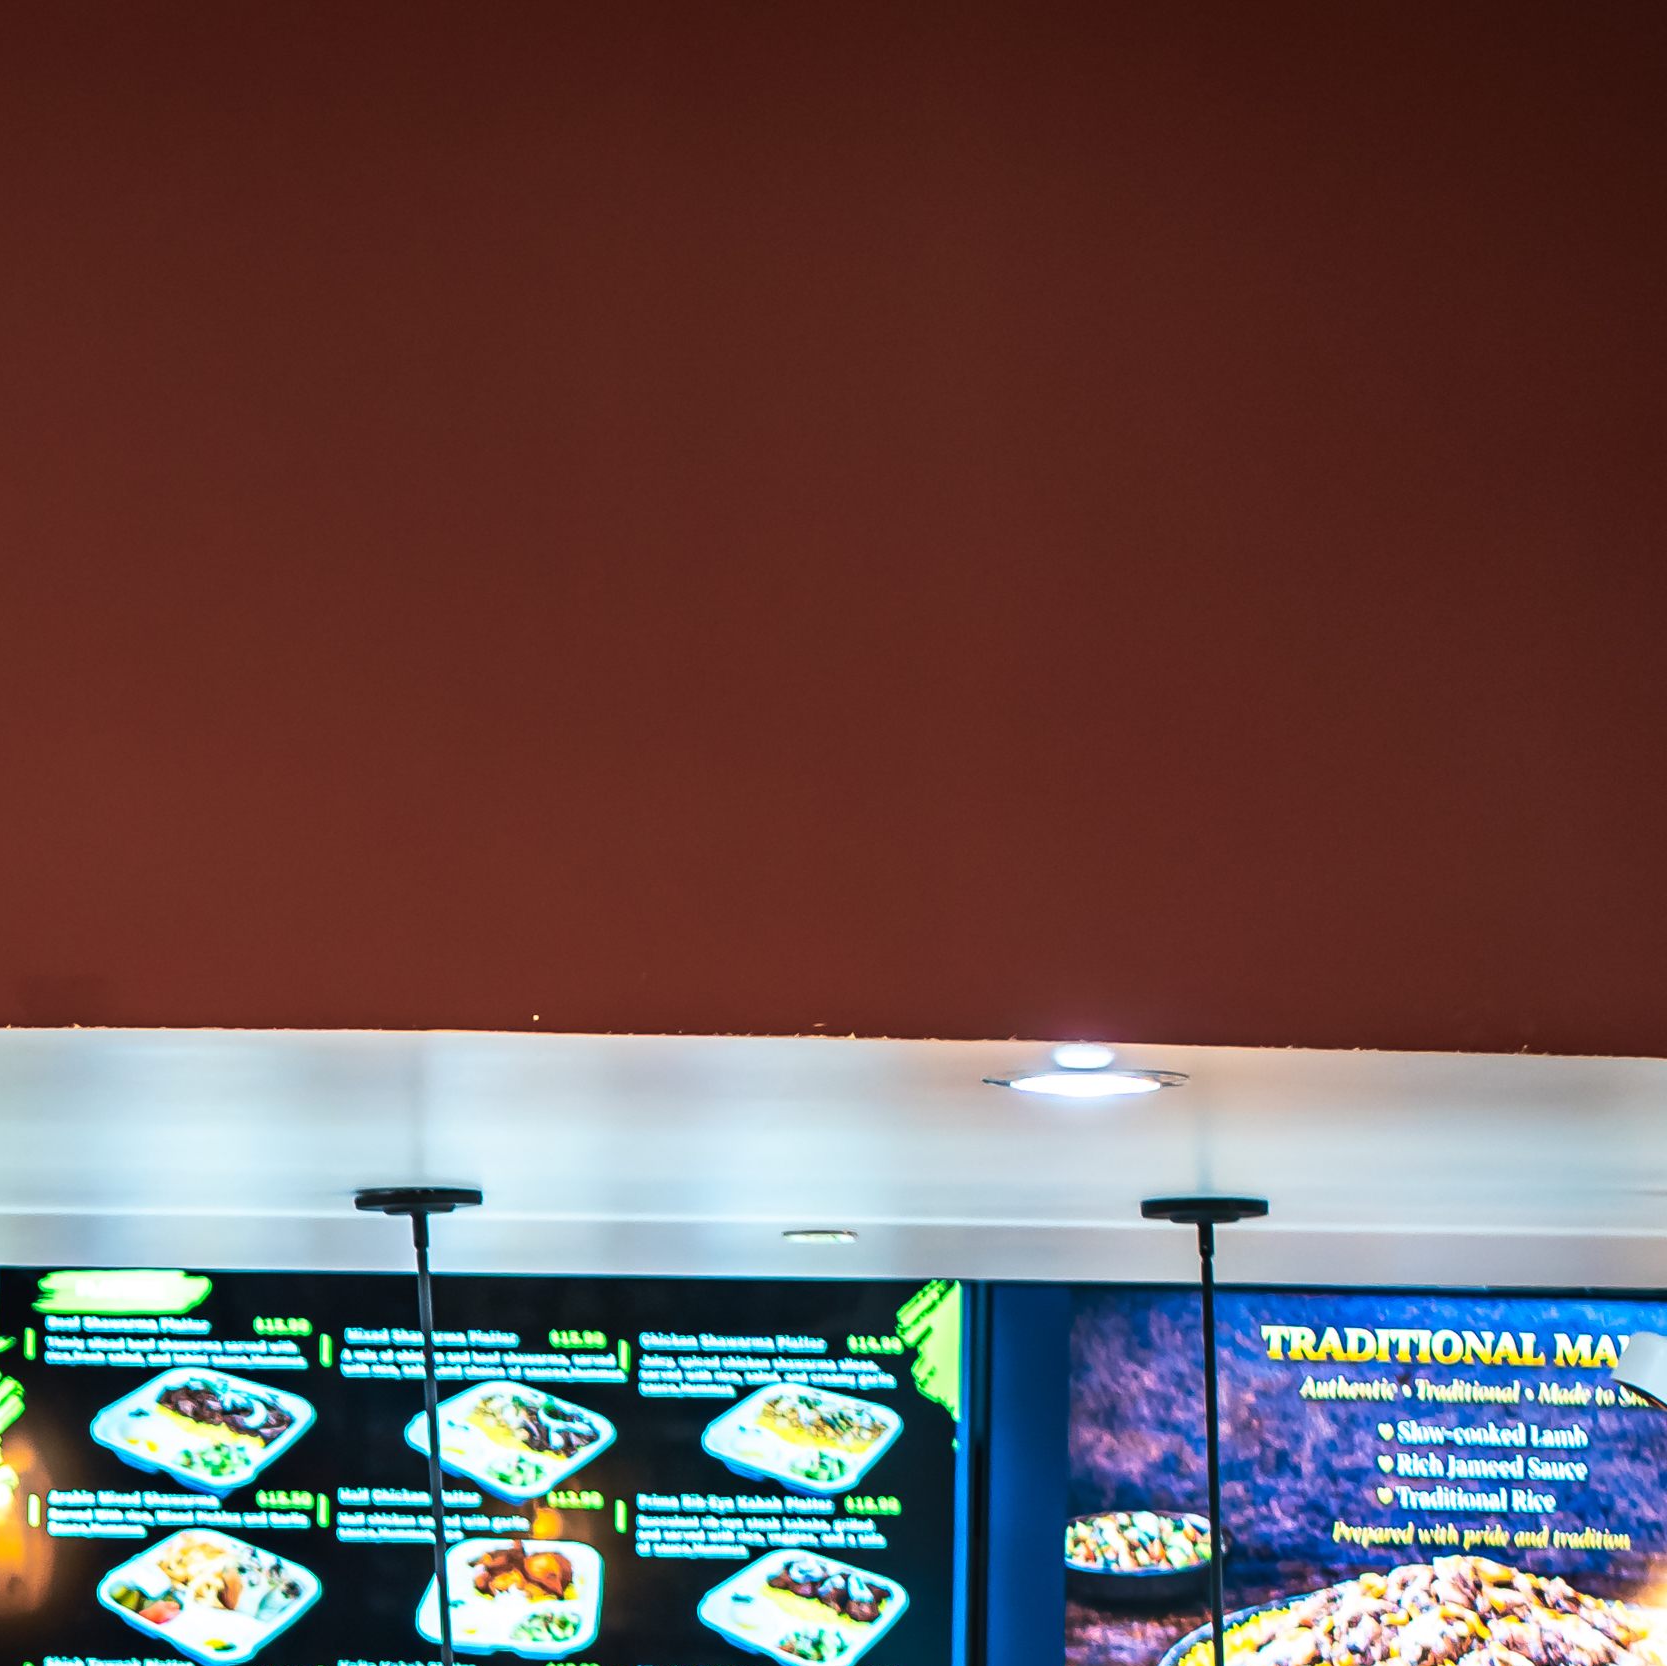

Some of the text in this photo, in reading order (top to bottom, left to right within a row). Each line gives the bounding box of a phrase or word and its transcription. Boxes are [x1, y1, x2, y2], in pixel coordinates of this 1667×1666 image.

[1261, 1324, 1545, 1367] TRADITIONAL
[1300, 1376, 1615, 1406] Authentic Traditional Made to
[1397, 1420, 1589, 1449] Slow-cooked Lamb
[1397, 1453, 1588, 1481] Rich Jameed Sauce
[1397, 1485, 1557, 1513] Traditional Rice
[1333, 1521, 1631, 1551] Prepared with pride and tradition
